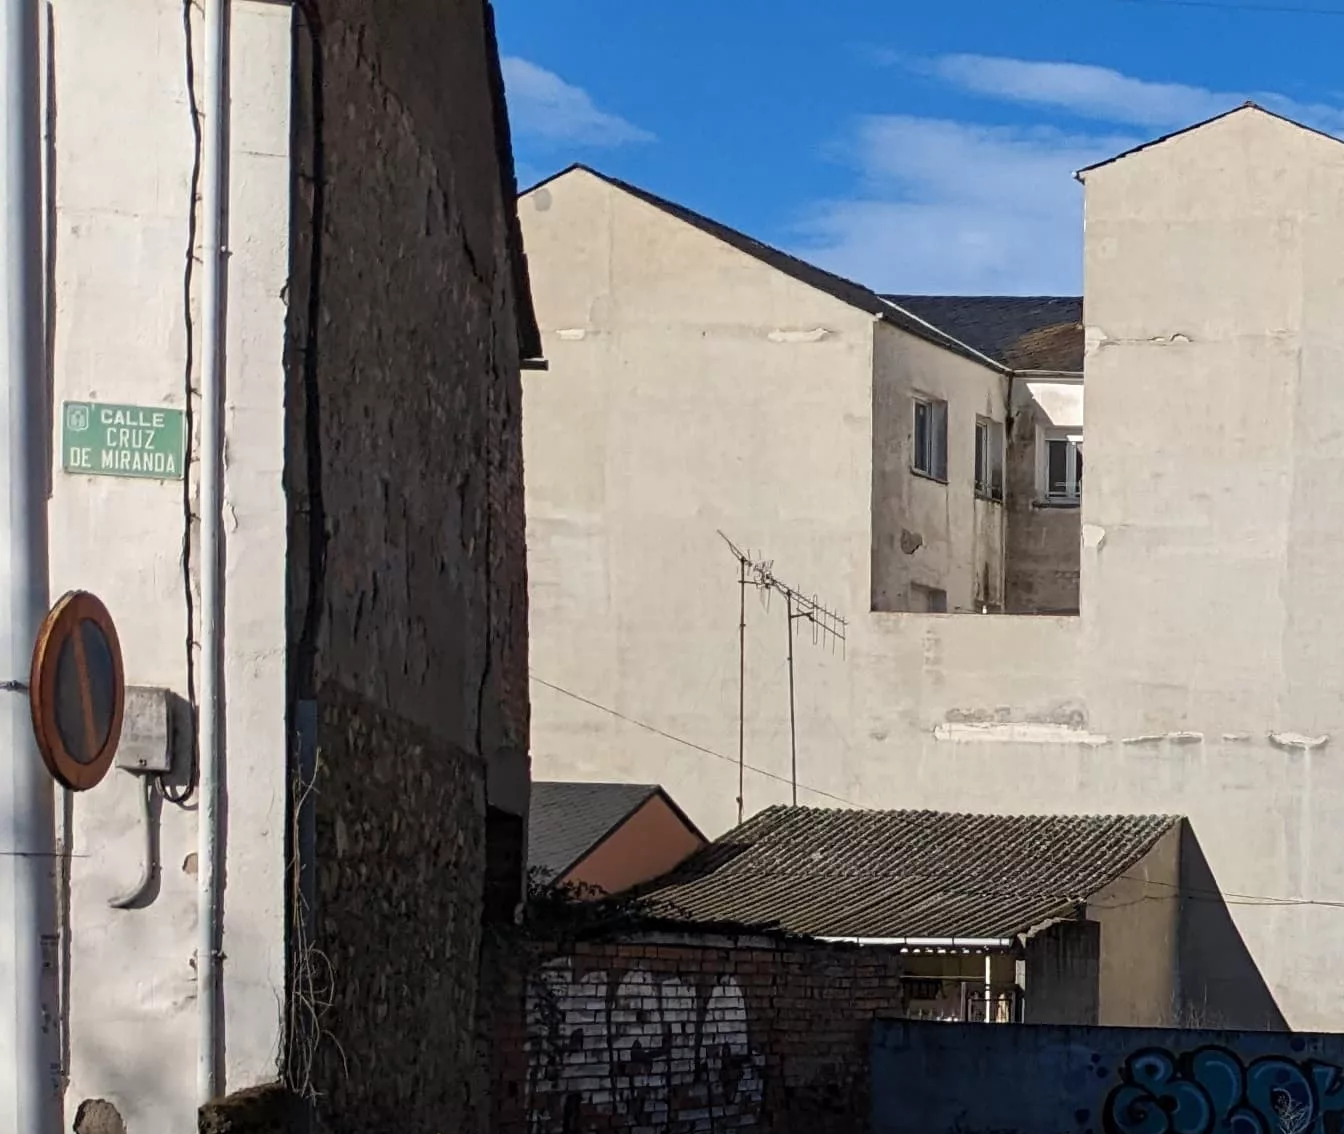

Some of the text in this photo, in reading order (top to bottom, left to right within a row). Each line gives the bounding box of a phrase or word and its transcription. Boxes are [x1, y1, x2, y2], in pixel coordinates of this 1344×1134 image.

[101, 409, 165, 428] CALLE
[107, 427, 155, 450] CRUZ
[70, 447, 176, 473] DE MIRANDA
